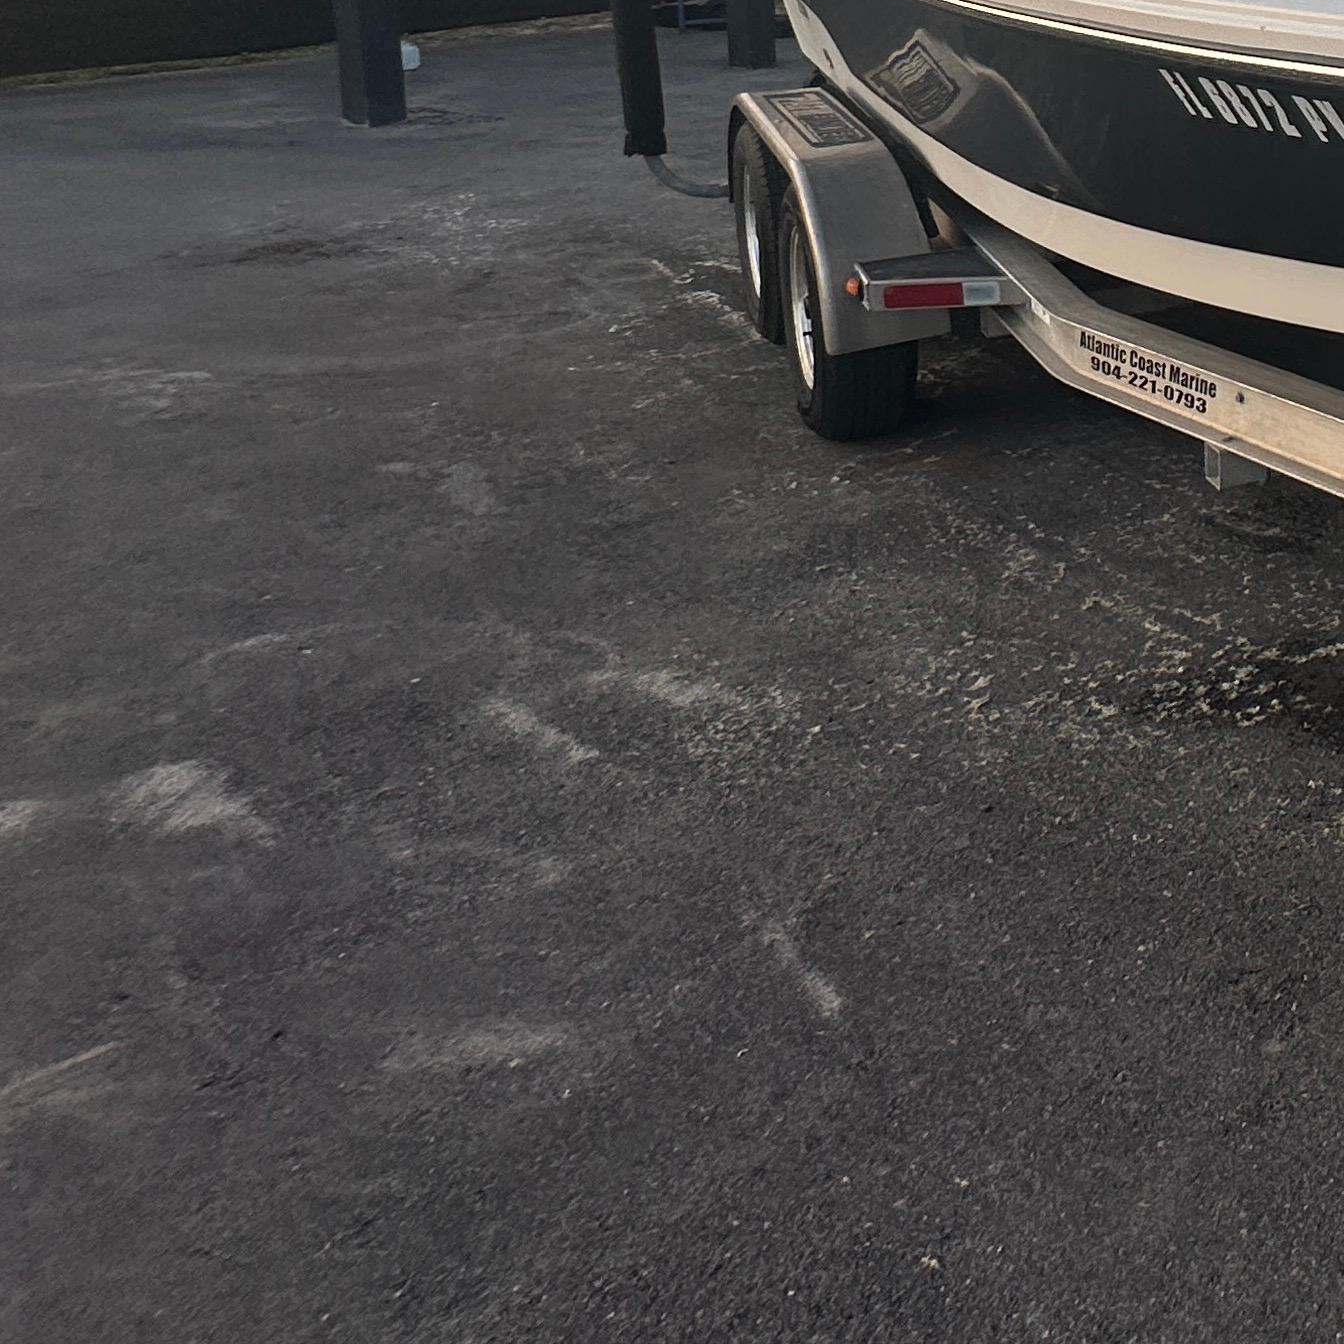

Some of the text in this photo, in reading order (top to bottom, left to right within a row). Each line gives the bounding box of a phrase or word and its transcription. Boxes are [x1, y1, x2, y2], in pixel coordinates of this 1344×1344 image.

[1157, 68, 1214, 119] FL
[1198, 76, 1303, 138] 6872
[1079, 330, 1217, 398] Atlantic Coast Marine
[1090, 356, 1208, 414] 904-221-0793
